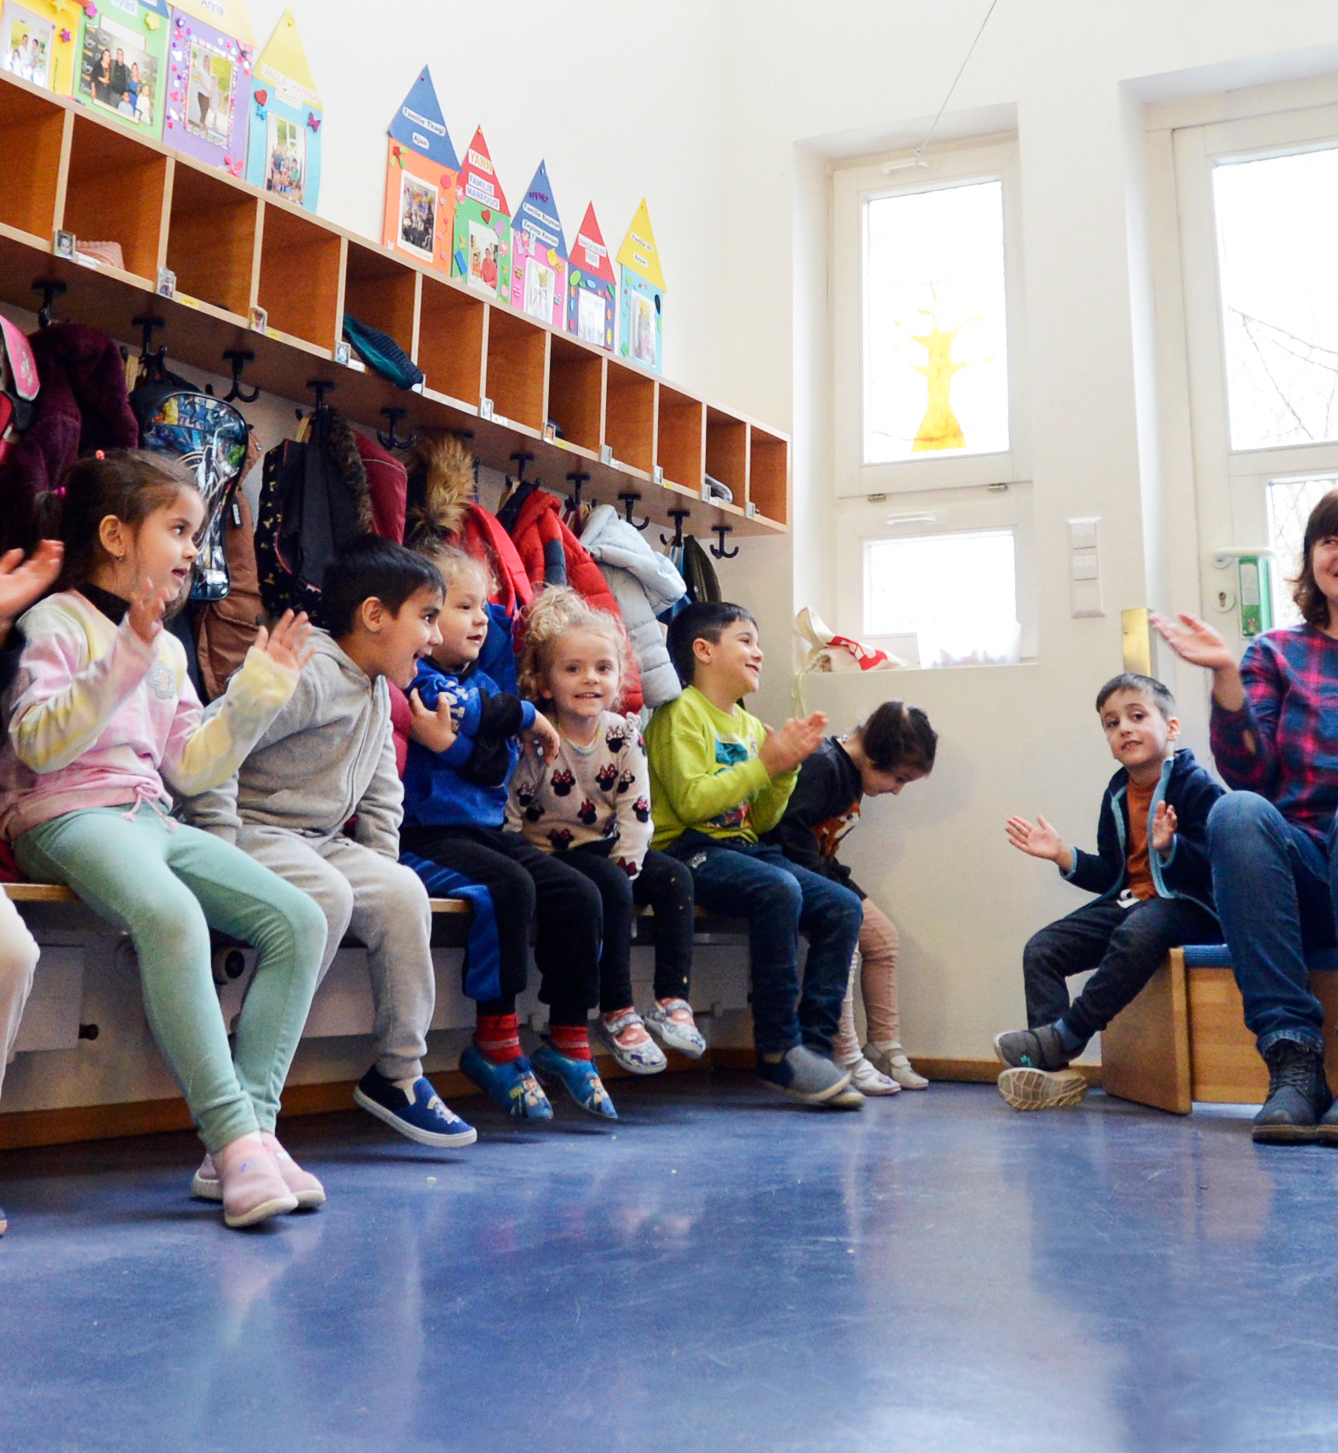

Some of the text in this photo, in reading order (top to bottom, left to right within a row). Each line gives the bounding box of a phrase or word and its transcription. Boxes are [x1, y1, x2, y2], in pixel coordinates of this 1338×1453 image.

[404, 108, 425, 125] Familie
[469, 151, 493, 173] YANN
[469, 174, 494, 194] FAMILIE
